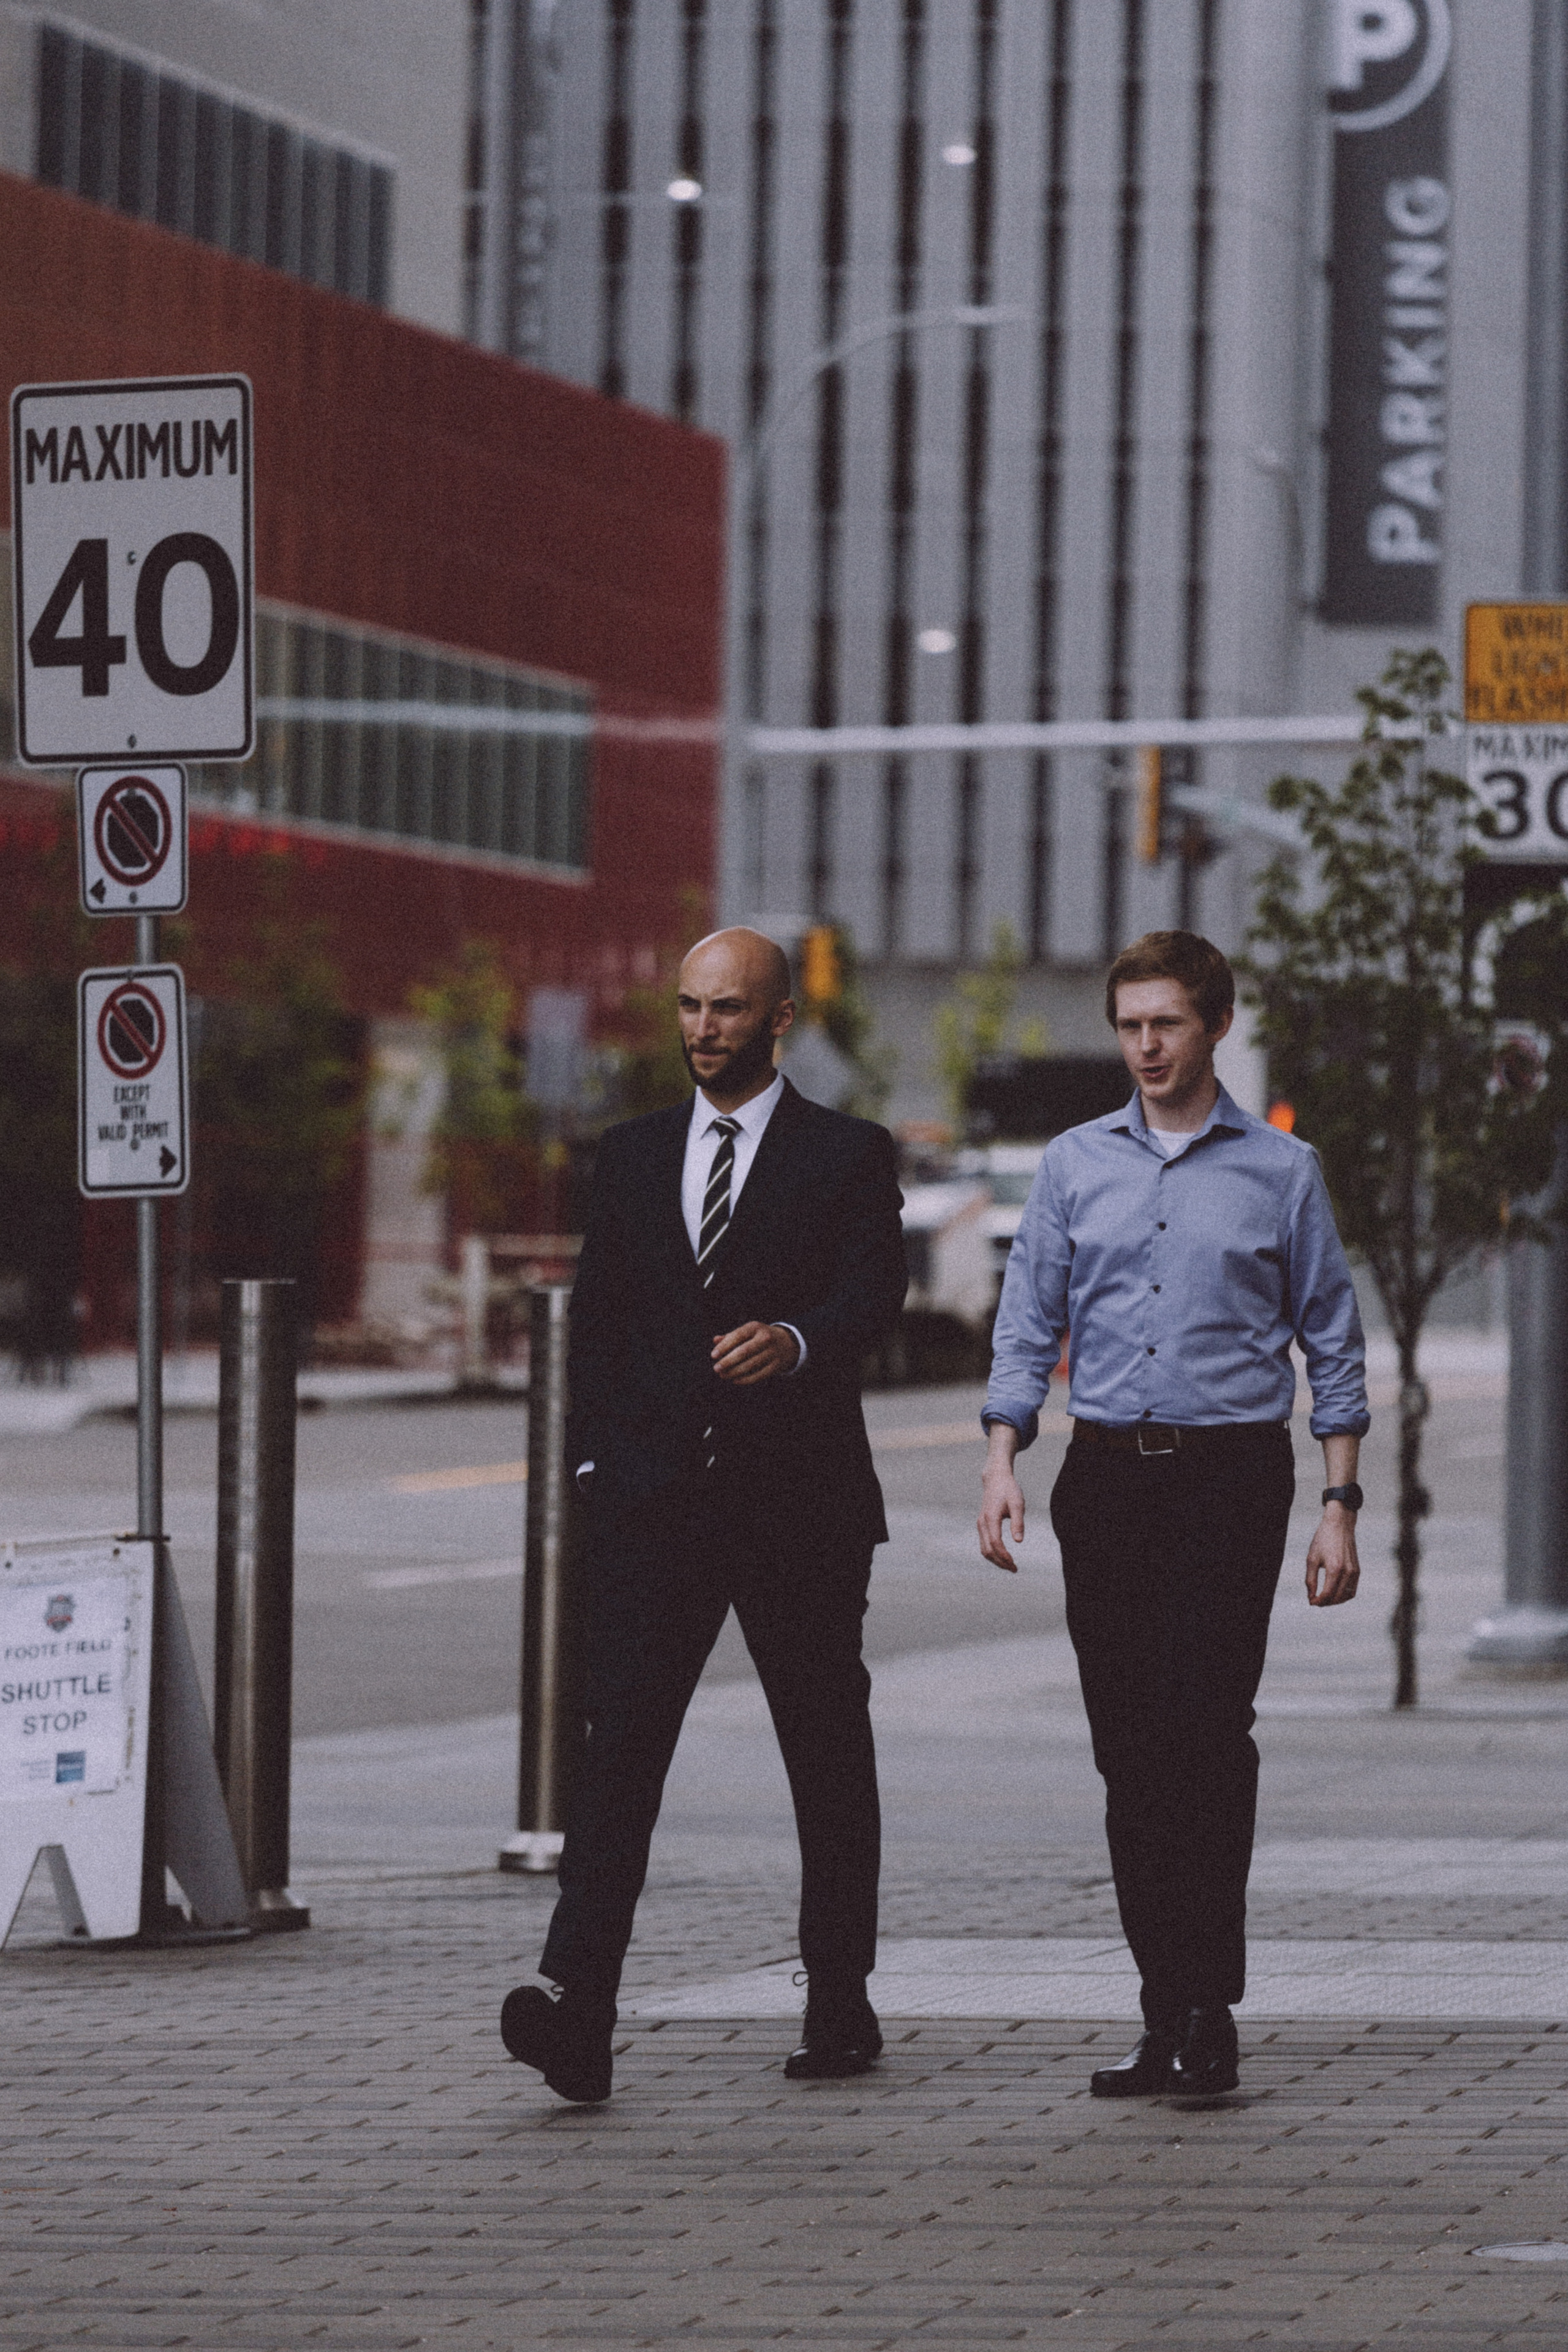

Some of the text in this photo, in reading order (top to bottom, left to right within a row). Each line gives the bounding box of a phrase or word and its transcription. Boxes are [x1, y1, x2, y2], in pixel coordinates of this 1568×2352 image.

[1330, 0, 1417, 90] P
[1366, 174, 1451, 564] PARKING
[25, 418, 238, 484] MAXIMUM
[28, 531, 239, 697] 40
[113, 1084, 149, 1103] EXCEPT
[120, 1105, 146, 1120] WITH
[98, 1121, 168, 1141] VALID PERMIT
[4, 1639, 112, 1660] FOOTE FIELD
[1, 1673, 112, 1705] SHUTTLE
[22, 1711, 88, 1735] STOP
